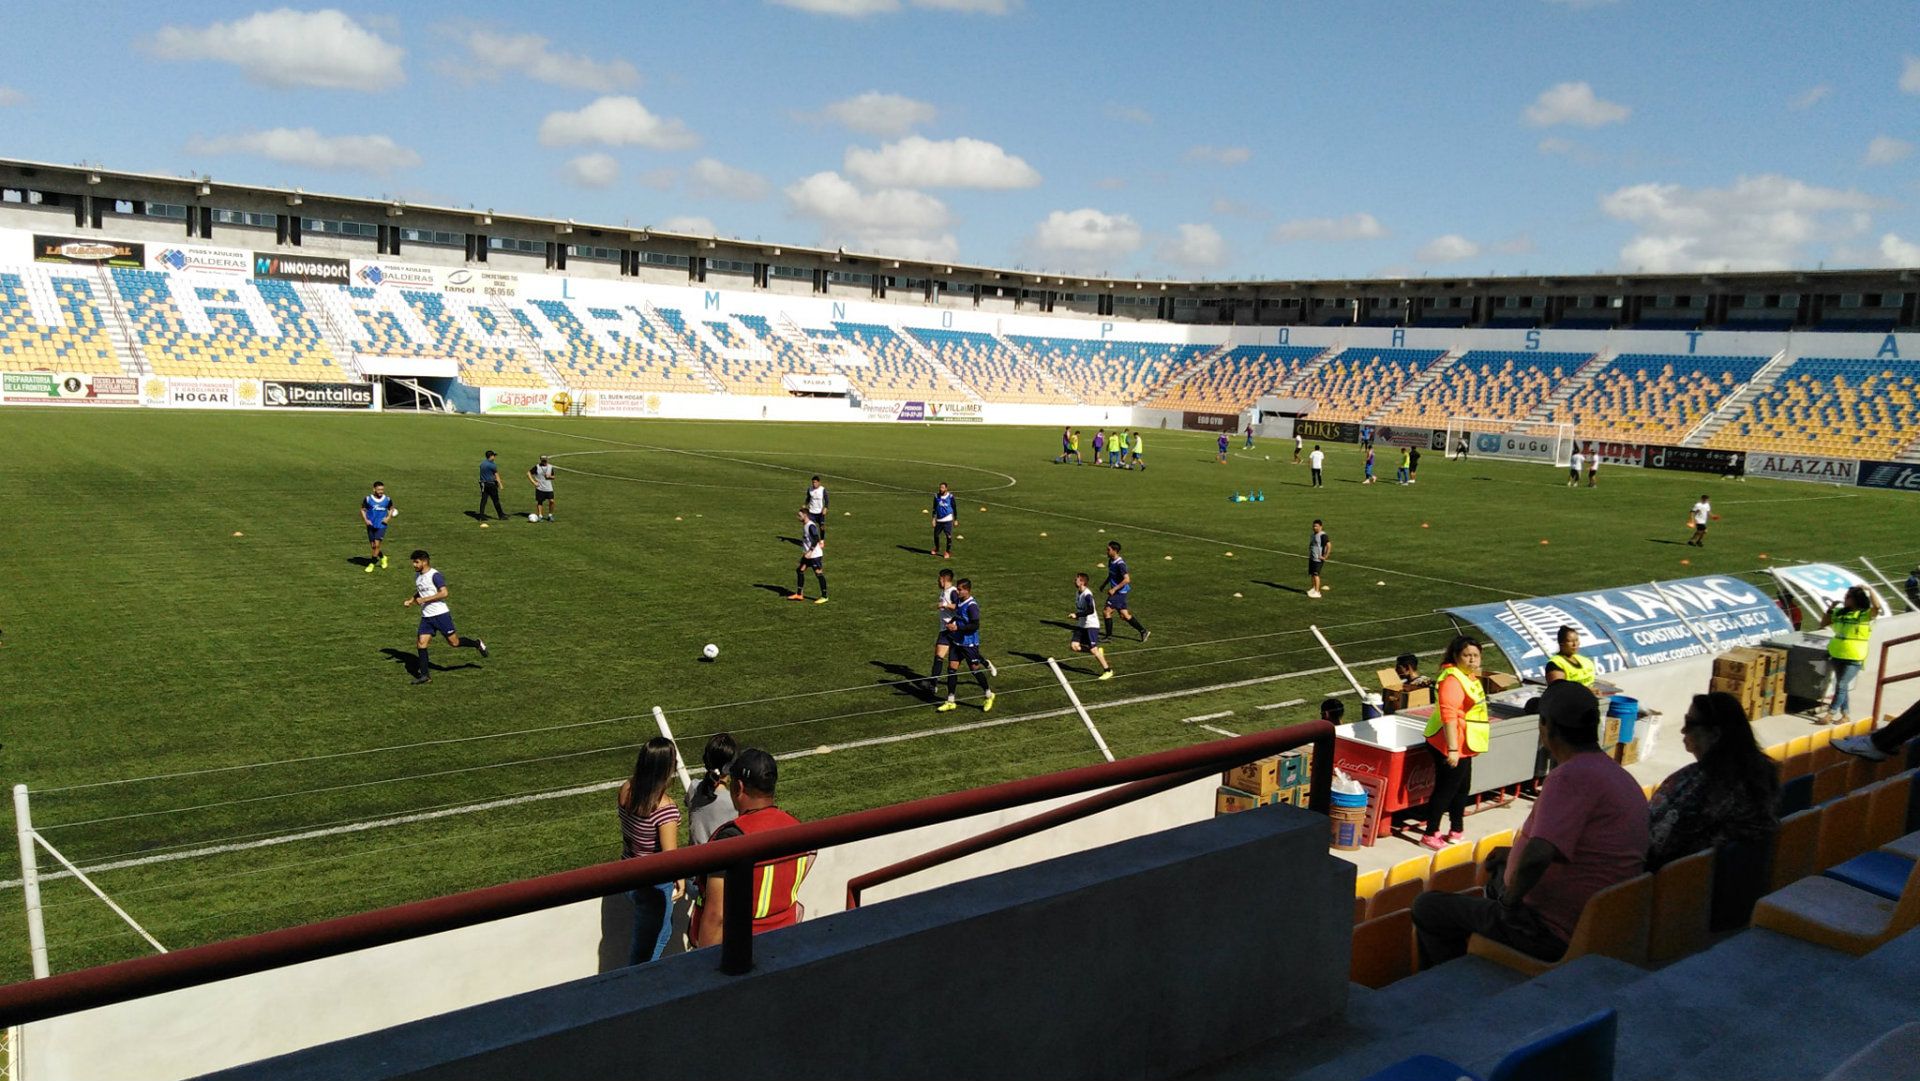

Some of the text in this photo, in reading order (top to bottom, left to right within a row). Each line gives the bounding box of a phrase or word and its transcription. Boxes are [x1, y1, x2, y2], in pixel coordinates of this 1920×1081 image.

[185, 256, 247, 268] BALDERAS
[382, 272, 434, 283] BALDERAS
[444, 285, 475, 294] tancol
[562, 278, 576, 300] L
[705, 290, 720, 311] M
[832, 302, 846, 320] N
[1100, 322, 1114, 338] P
[1525, 330, 1541, 350] S
[1685, 332, 1703, 354] T
[1876, 334, 1900, 358] A
[175, 393, 228, 402] HOGAR
[289, 386, 371, 402] iPantallas
[1210, 416, 1224, 426] GYM
[1762, 457, 1853, 477] ALAZAN
[1576, 578, 1758, 624] KAWAC
